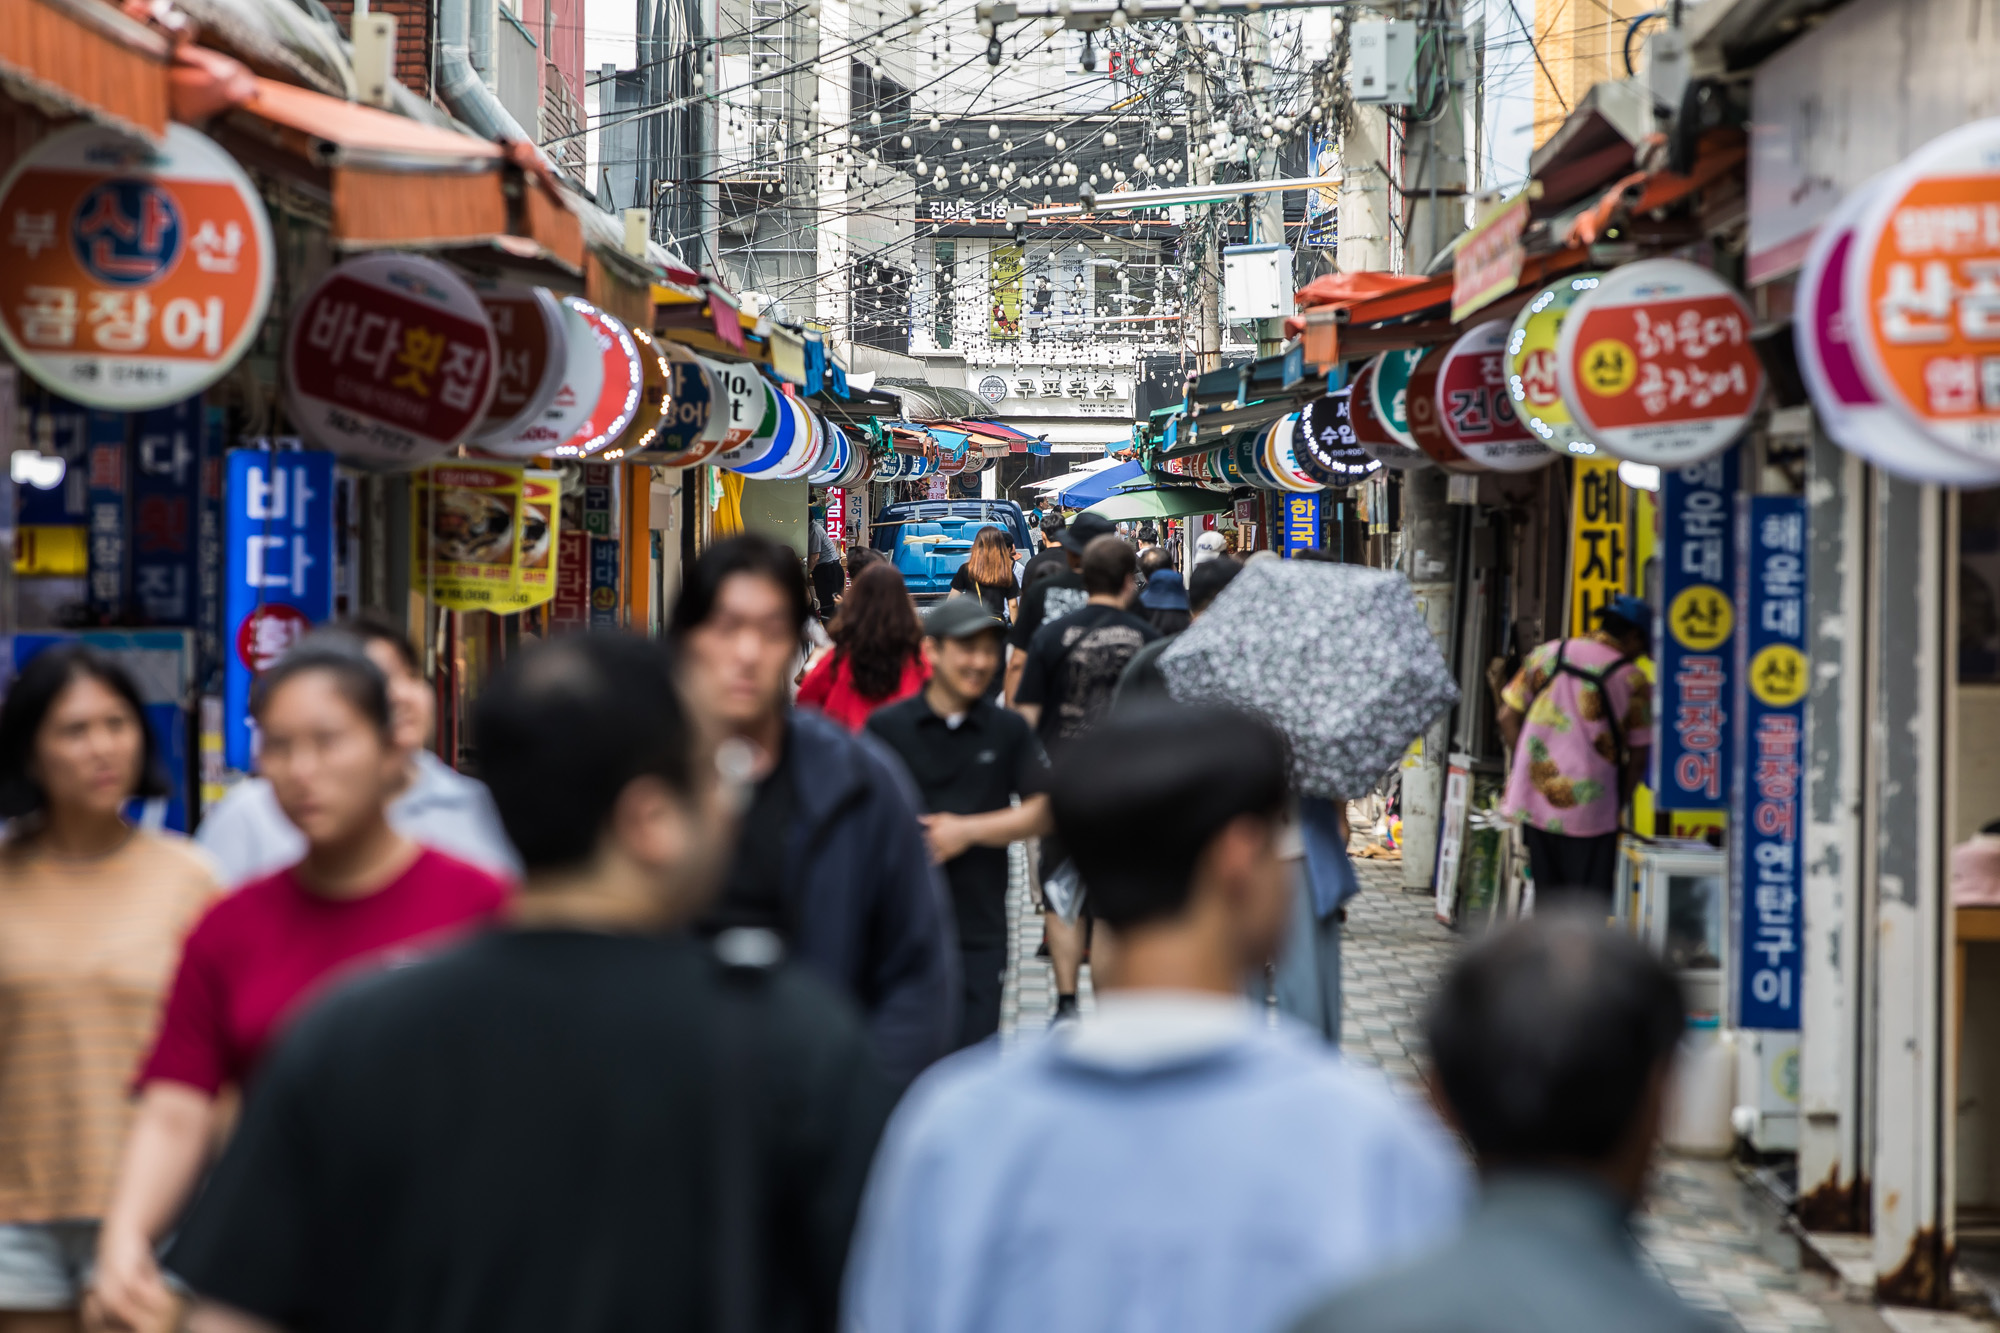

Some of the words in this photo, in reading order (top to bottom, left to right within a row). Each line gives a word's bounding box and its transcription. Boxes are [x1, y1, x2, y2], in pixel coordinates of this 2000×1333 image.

[929, 201, 976, 220] 진심을
[981, 201, 1028, 220] 다하
[18, 286, 223, 356] 곰장어
[307, 299, 489, 413] 바다횟집
[1014, 379, 1117, 402] 구포국수
[246, 465, 315, 598] 바다
[1760, 514, 1803, 637] 해운대
[1680, 597, 1722, 638] 산
[1762, 653, 1798, 695] 산
[1676, 656, 1726, 799] 곰장어
[1754, 714, 1800, 841] 곰장어
[1752, 841, 1797, 1009] 연탄구이
